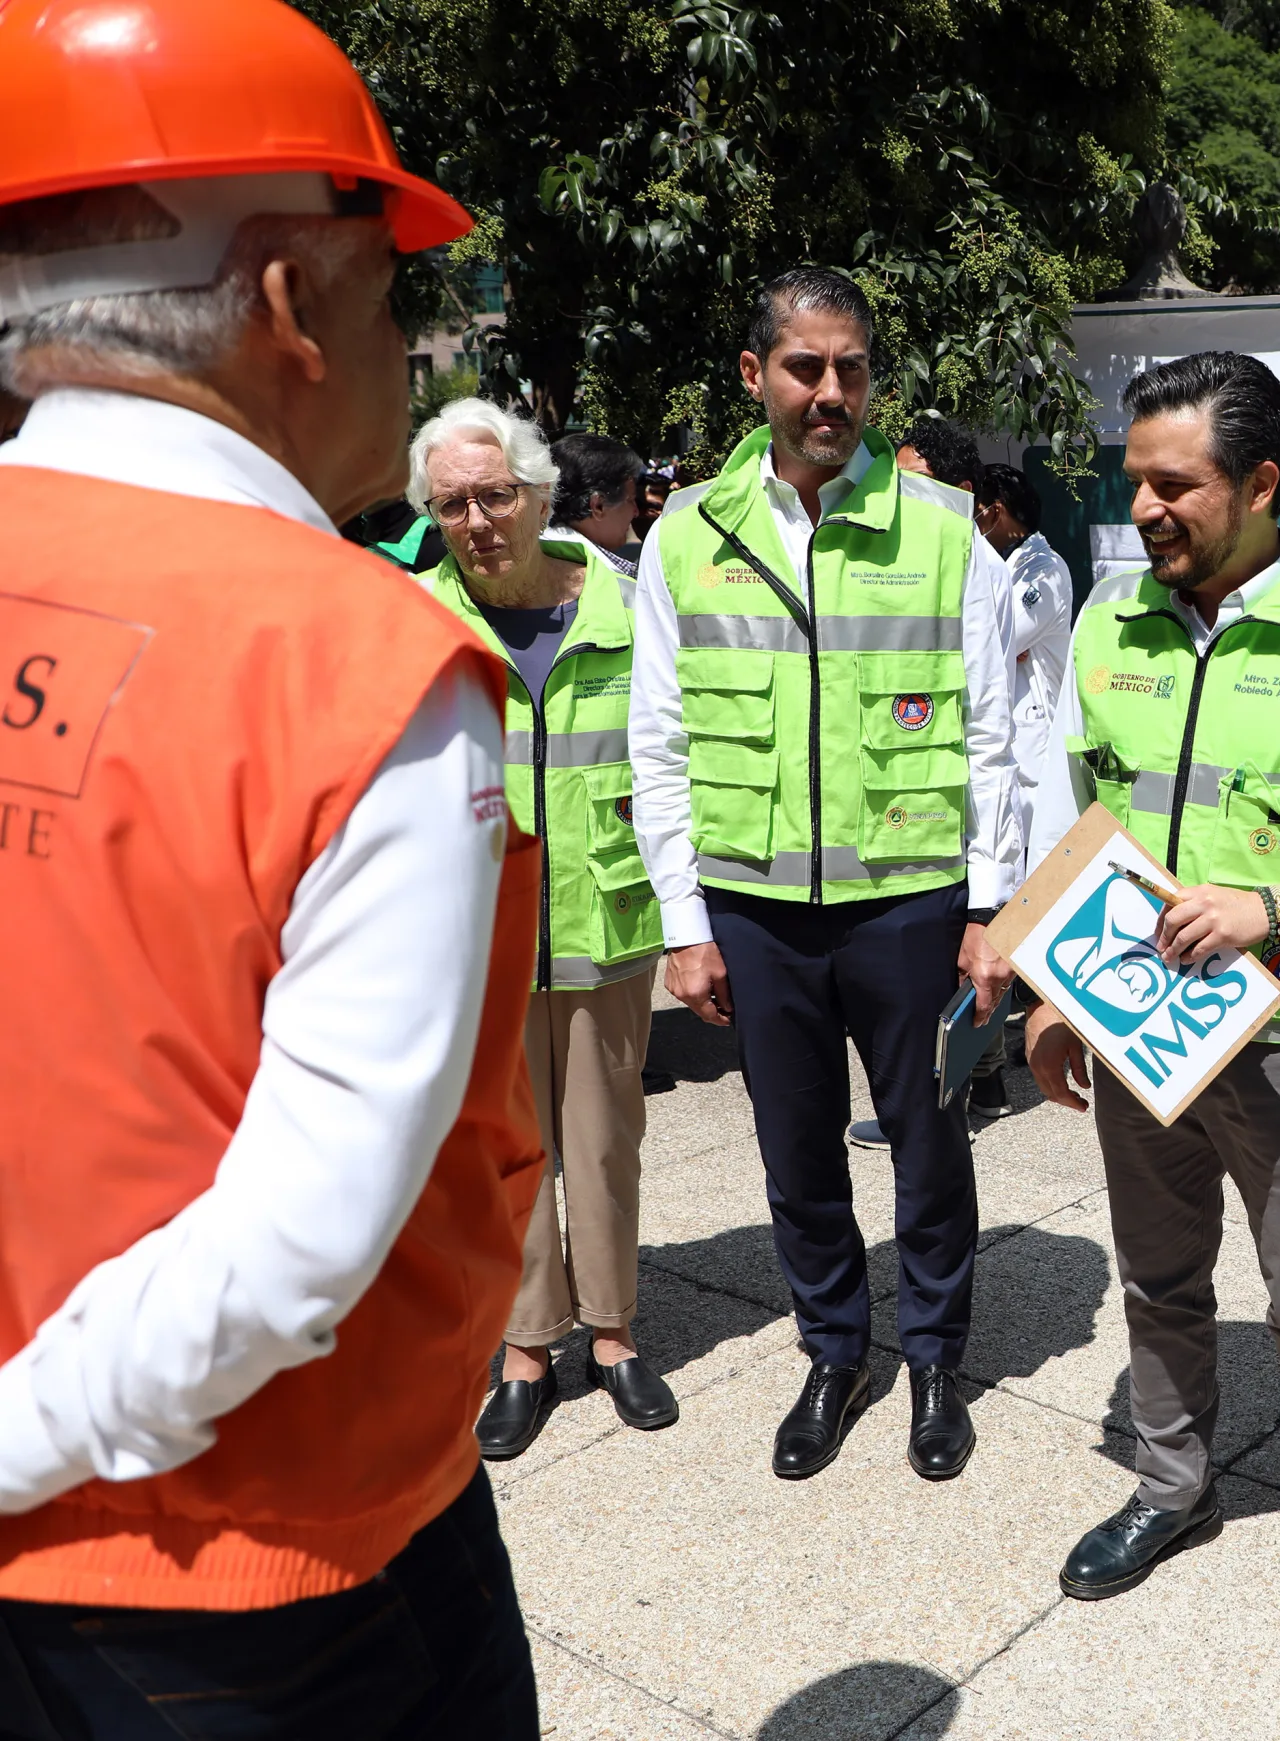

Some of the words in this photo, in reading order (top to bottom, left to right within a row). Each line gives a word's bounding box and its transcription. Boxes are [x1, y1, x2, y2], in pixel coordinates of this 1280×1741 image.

[725, 568, 758, 576] GOBIER
[725, 574, 764, 584] MÉXIC
[1112, 673, 1144, 682] GOBIERNO
[1243, 674, 1269, 685] Mtro.
[1109, 680, 1152, 694] MÉXICO
[1233, 683, 1273, 697] Robledo
[1124, 952, 1248, 1089] IMSS
